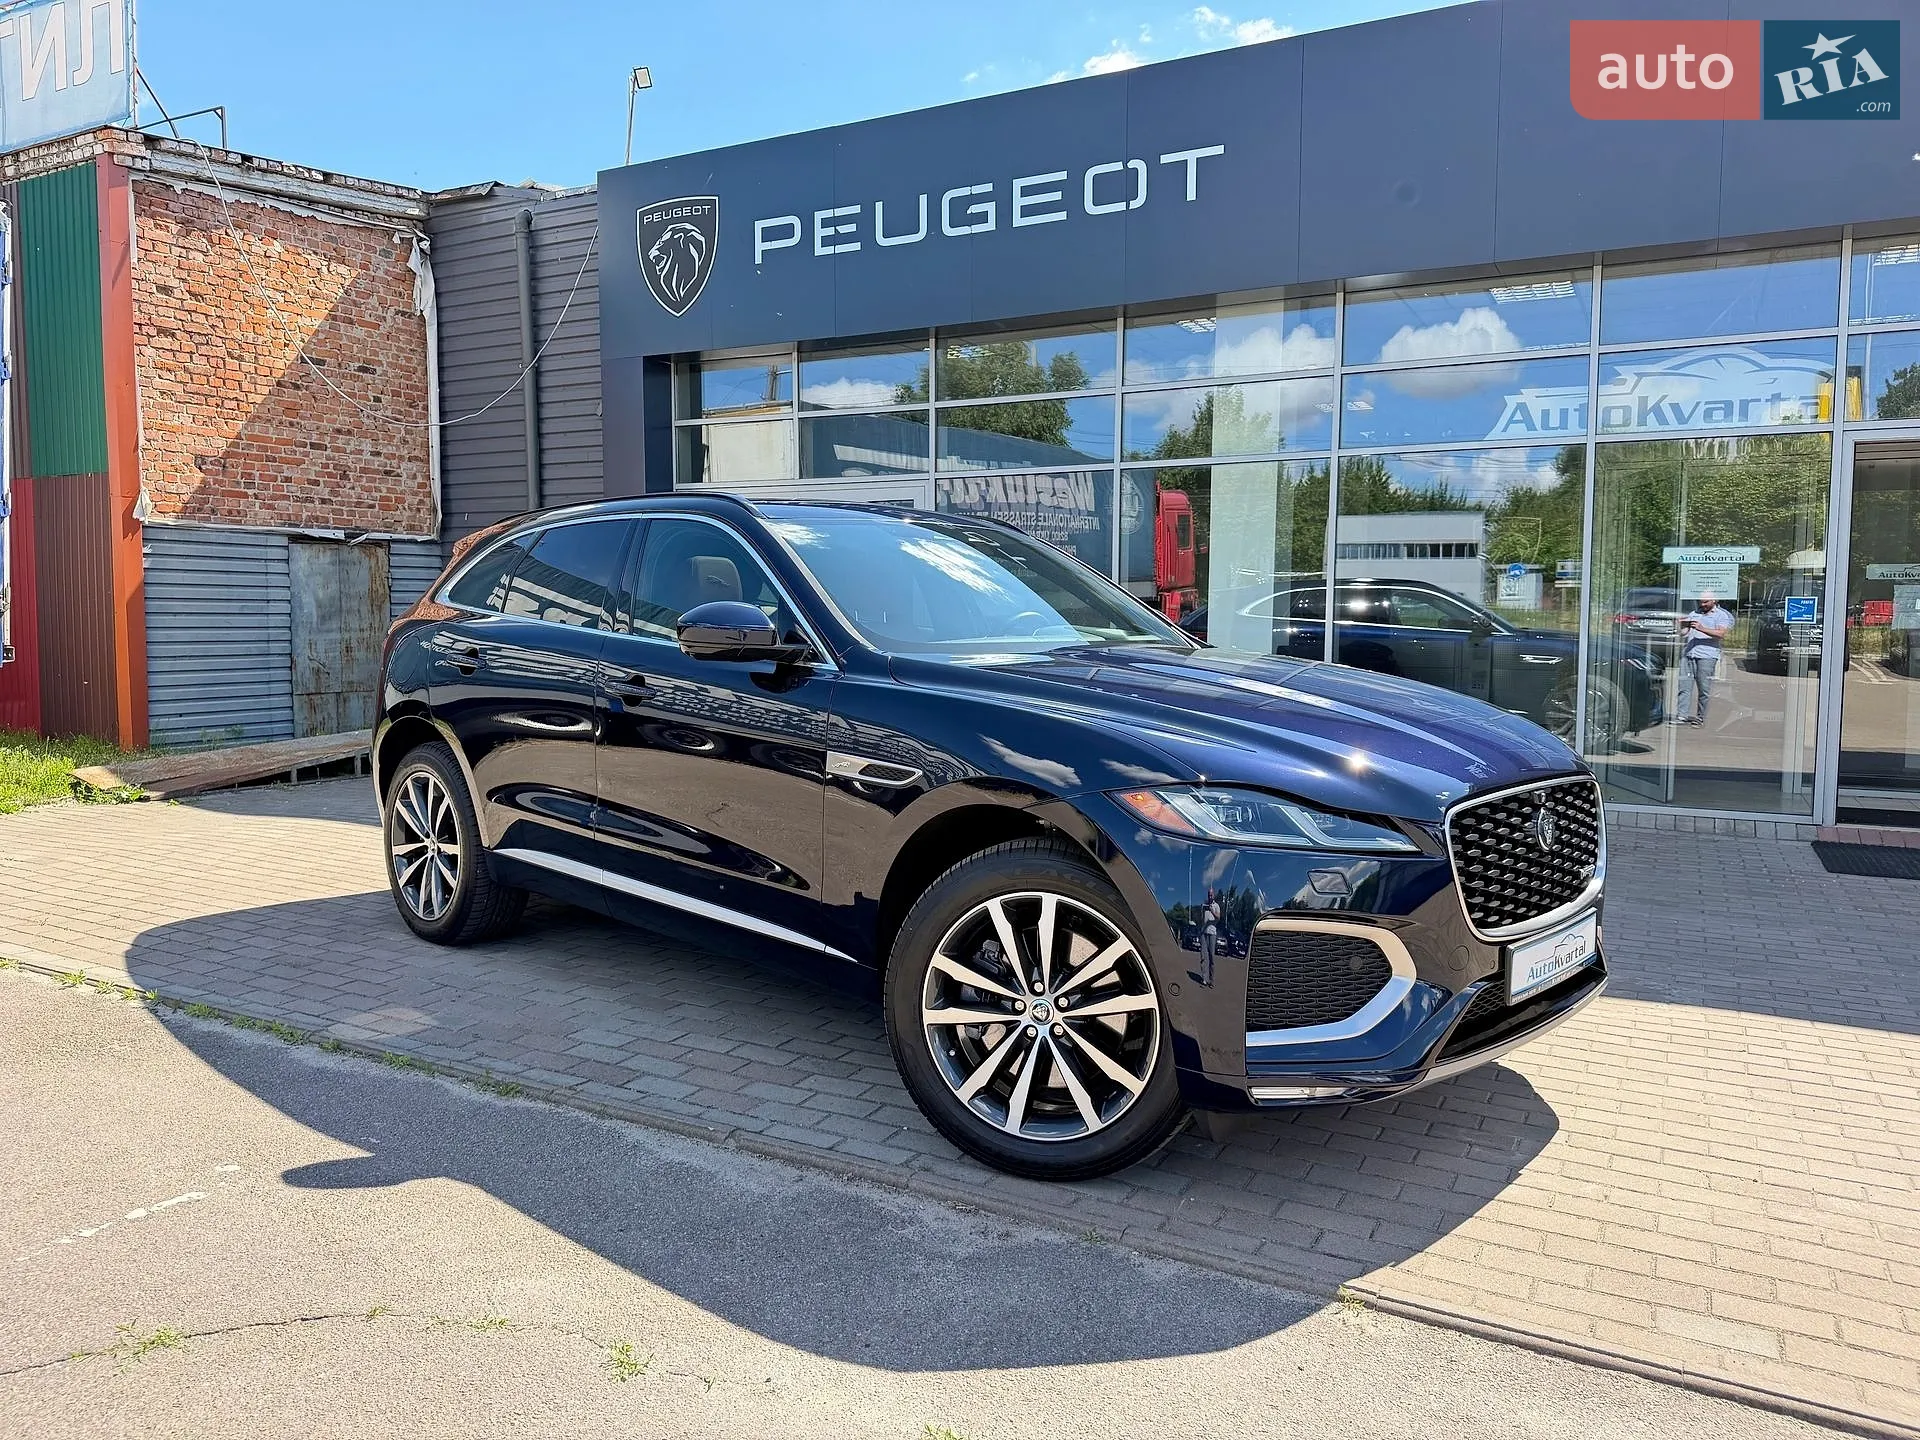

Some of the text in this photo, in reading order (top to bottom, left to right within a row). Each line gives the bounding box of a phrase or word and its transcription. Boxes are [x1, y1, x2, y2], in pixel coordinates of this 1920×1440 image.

[643, 206, 711, 224] PEUGEOT
[754, 145, 1225, 264] PEUGEOT
[1502, 392, 1830, 433] AutoKvarta
[1677, 554, 1744, 562] AutoKvartal
[1527, 940, 1586, 983] AutoKvartal
